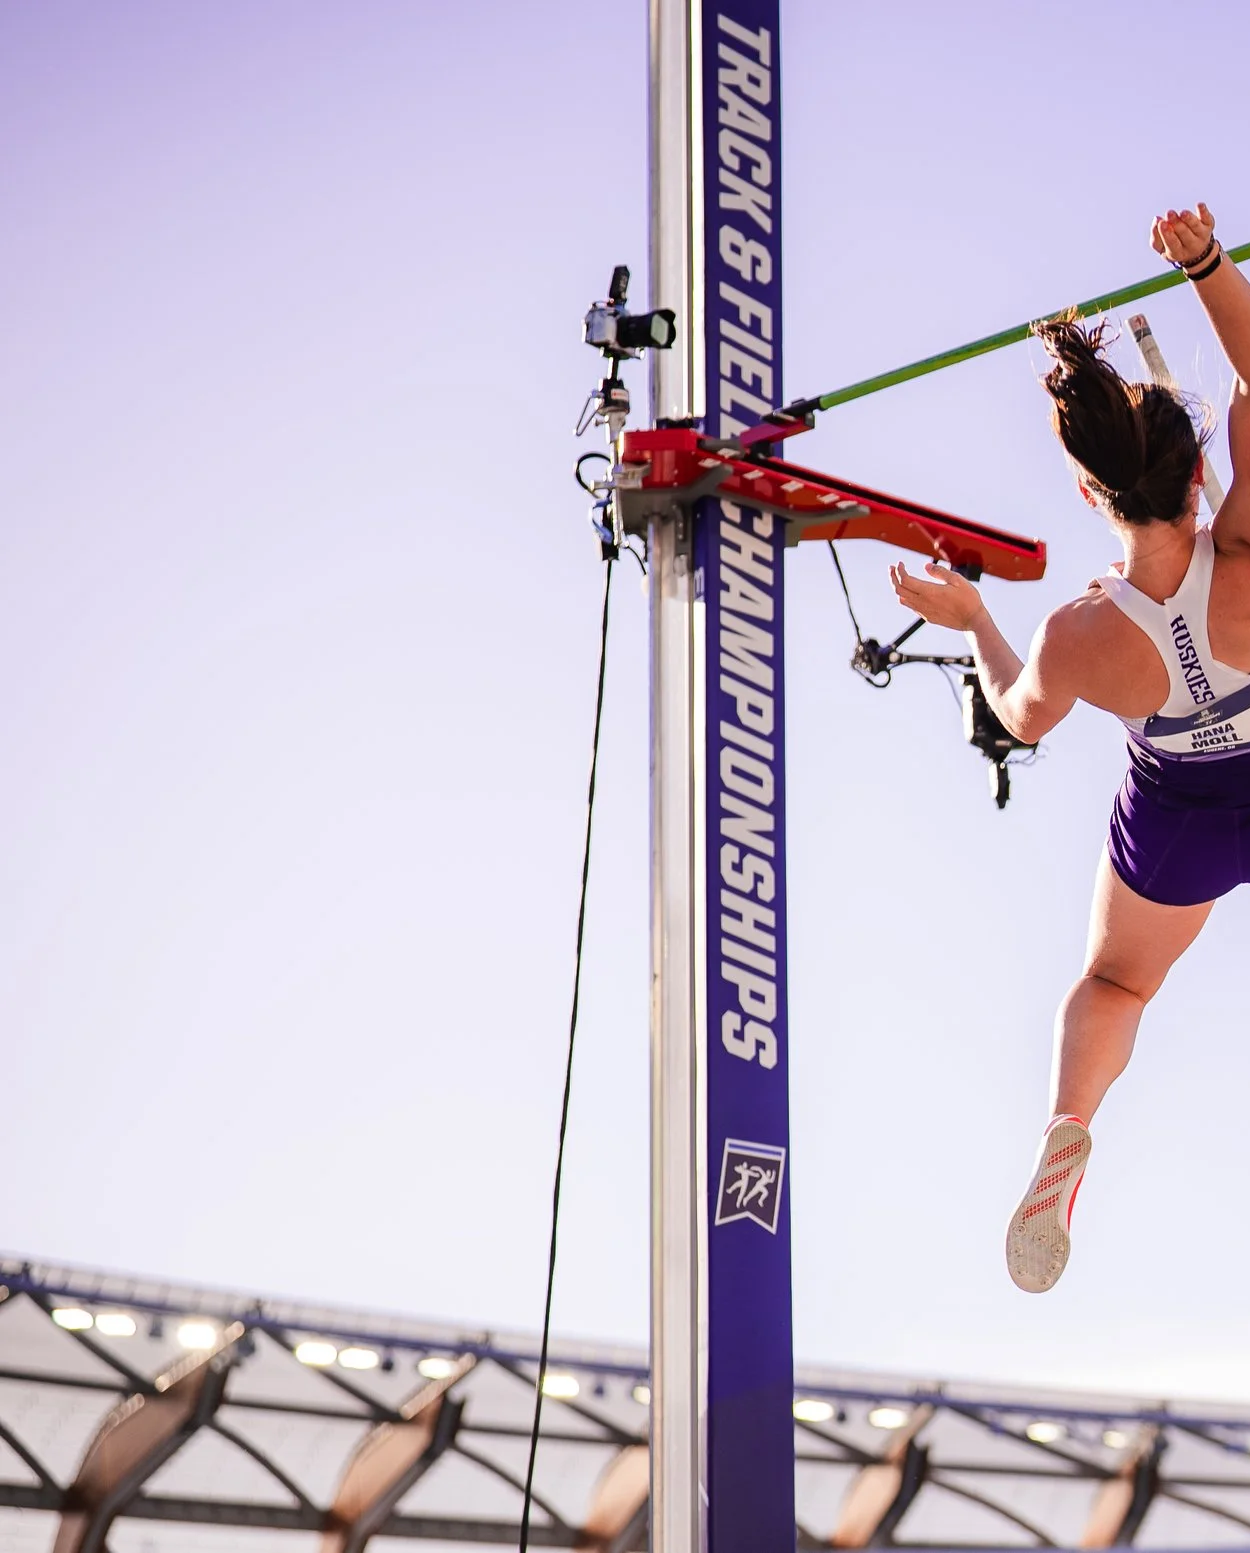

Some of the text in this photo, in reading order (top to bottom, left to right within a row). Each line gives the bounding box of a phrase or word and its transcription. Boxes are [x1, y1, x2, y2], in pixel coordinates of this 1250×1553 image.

[717, 13, 772, 235] TRACK
[719, 225, 772, 285] &
[1170, 614, 1216, 705] HUSKIES
[1191, 722, 1235, 740] HANA
[1191, 733, 1243, 749] MOLL
